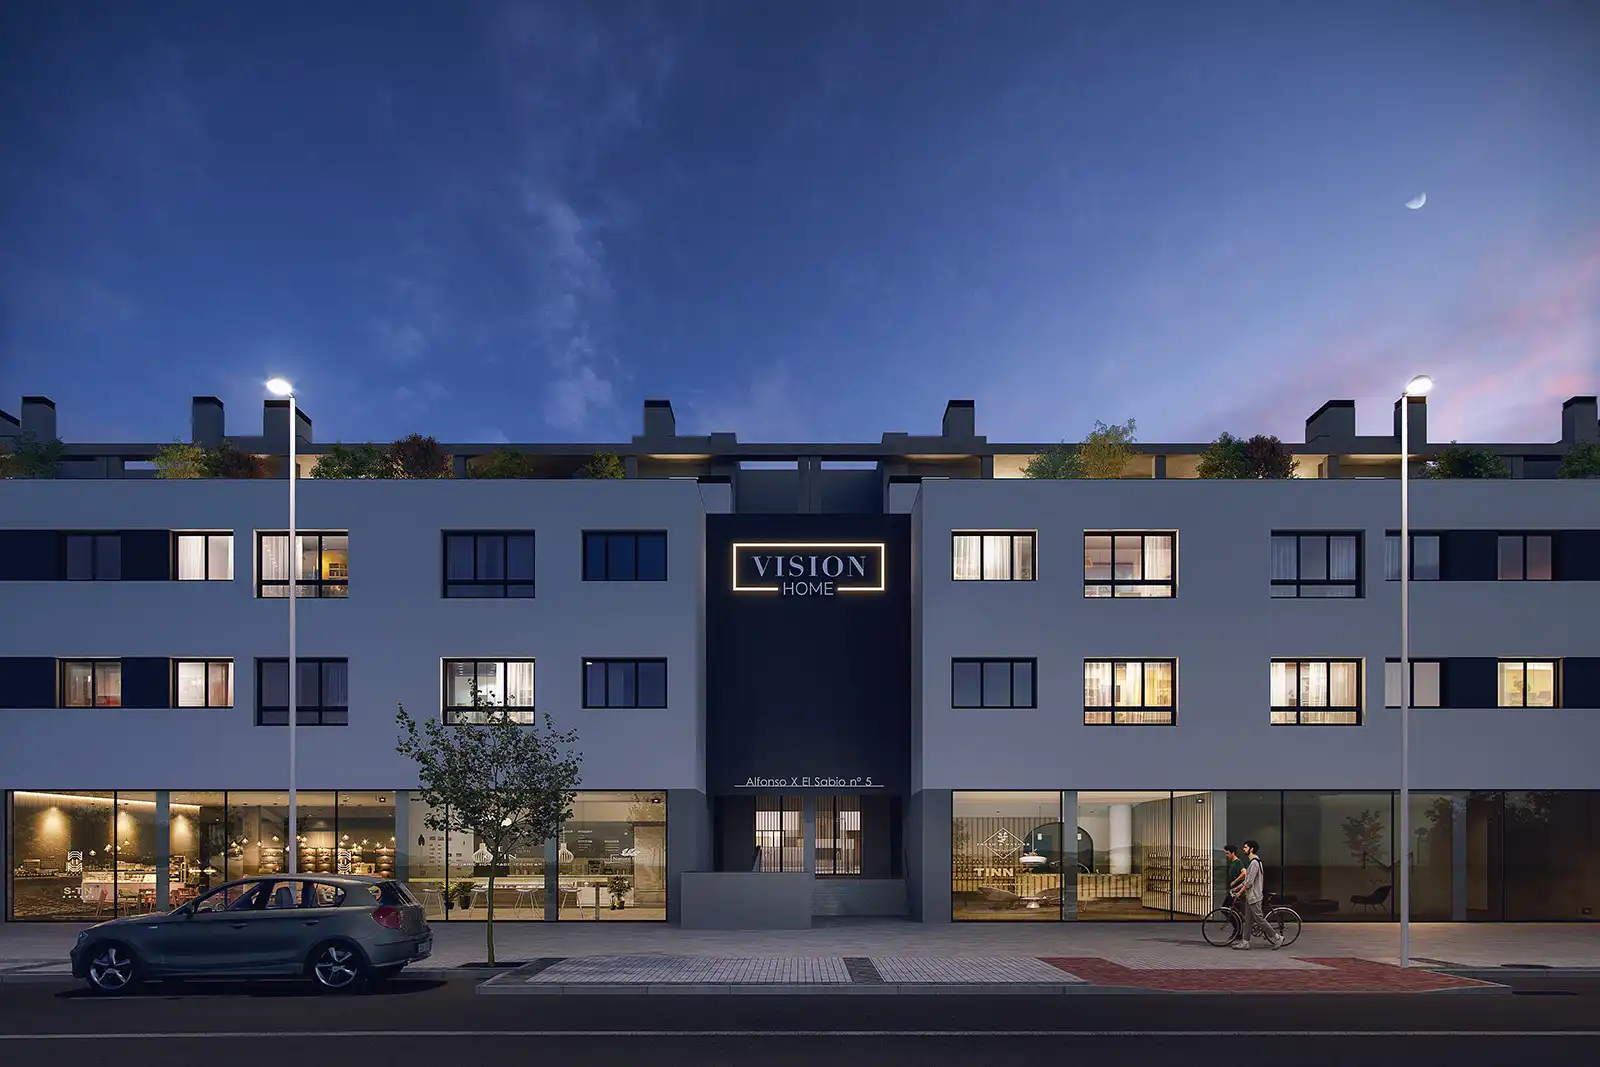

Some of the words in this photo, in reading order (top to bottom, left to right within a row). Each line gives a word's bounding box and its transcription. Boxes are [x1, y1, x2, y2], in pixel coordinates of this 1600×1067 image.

[750, 555, 867, 577] VISION
[783, 582, 834, 595] HOME
[745, 777, 787, 787] Alfonso
[790, 777, 798, 787] X
[802, 777, 811, 787] El
[814, 777, 846, 787] Sabio
[864, 777, 872, 787] 5
[973, 868, 1014, 877] TINN
